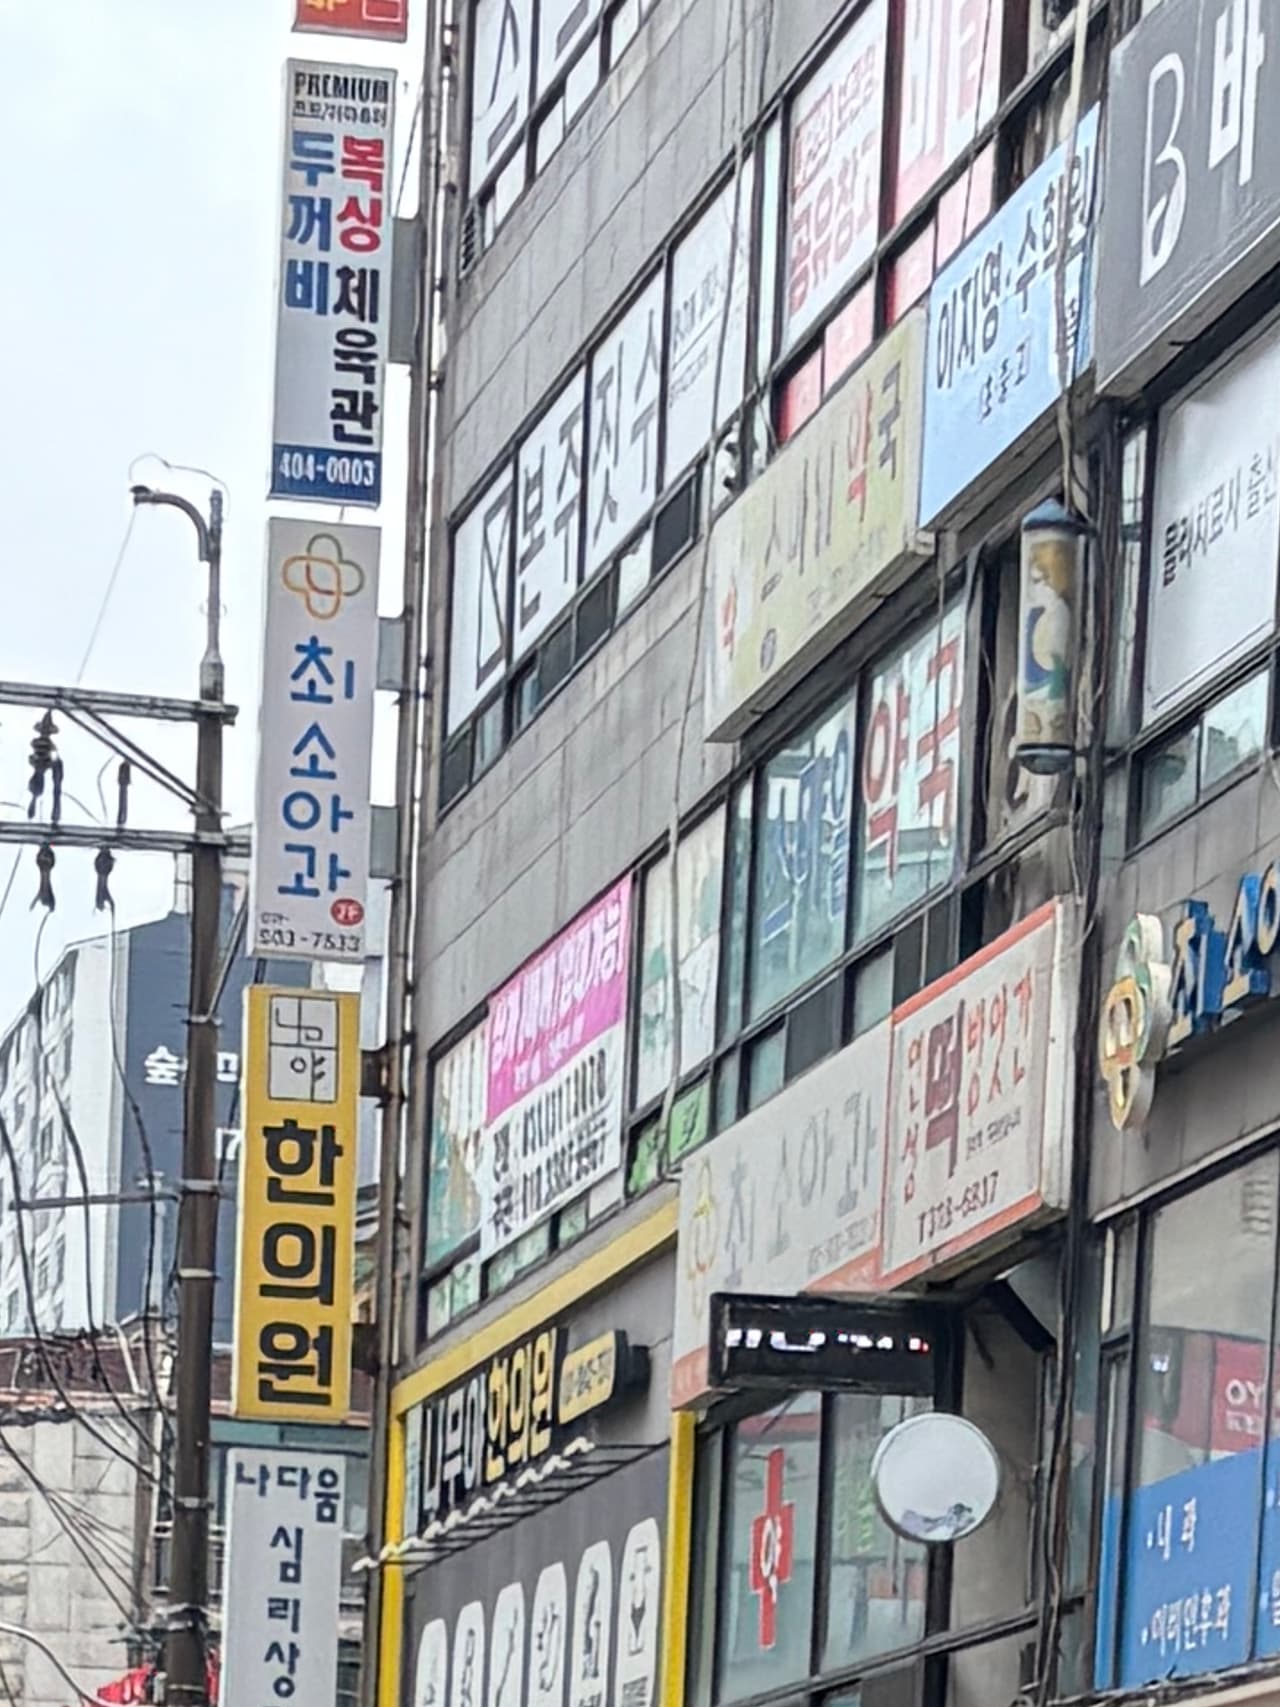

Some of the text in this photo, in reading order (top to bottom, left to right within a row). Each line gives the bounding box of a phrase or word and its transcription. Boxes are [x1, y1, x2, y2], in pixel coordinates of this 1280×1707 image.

[295, 71, 388, 104] PREMIUM
[284, 130, 335, 317] 두꺼비
[277, 634, 356, 899] 최소아과
[258, 1117, 344, 1408] 한의원
[235, 1459, 340, 1526] 나다움
[1150, 1583, 1232, 1658] 이비인후과
